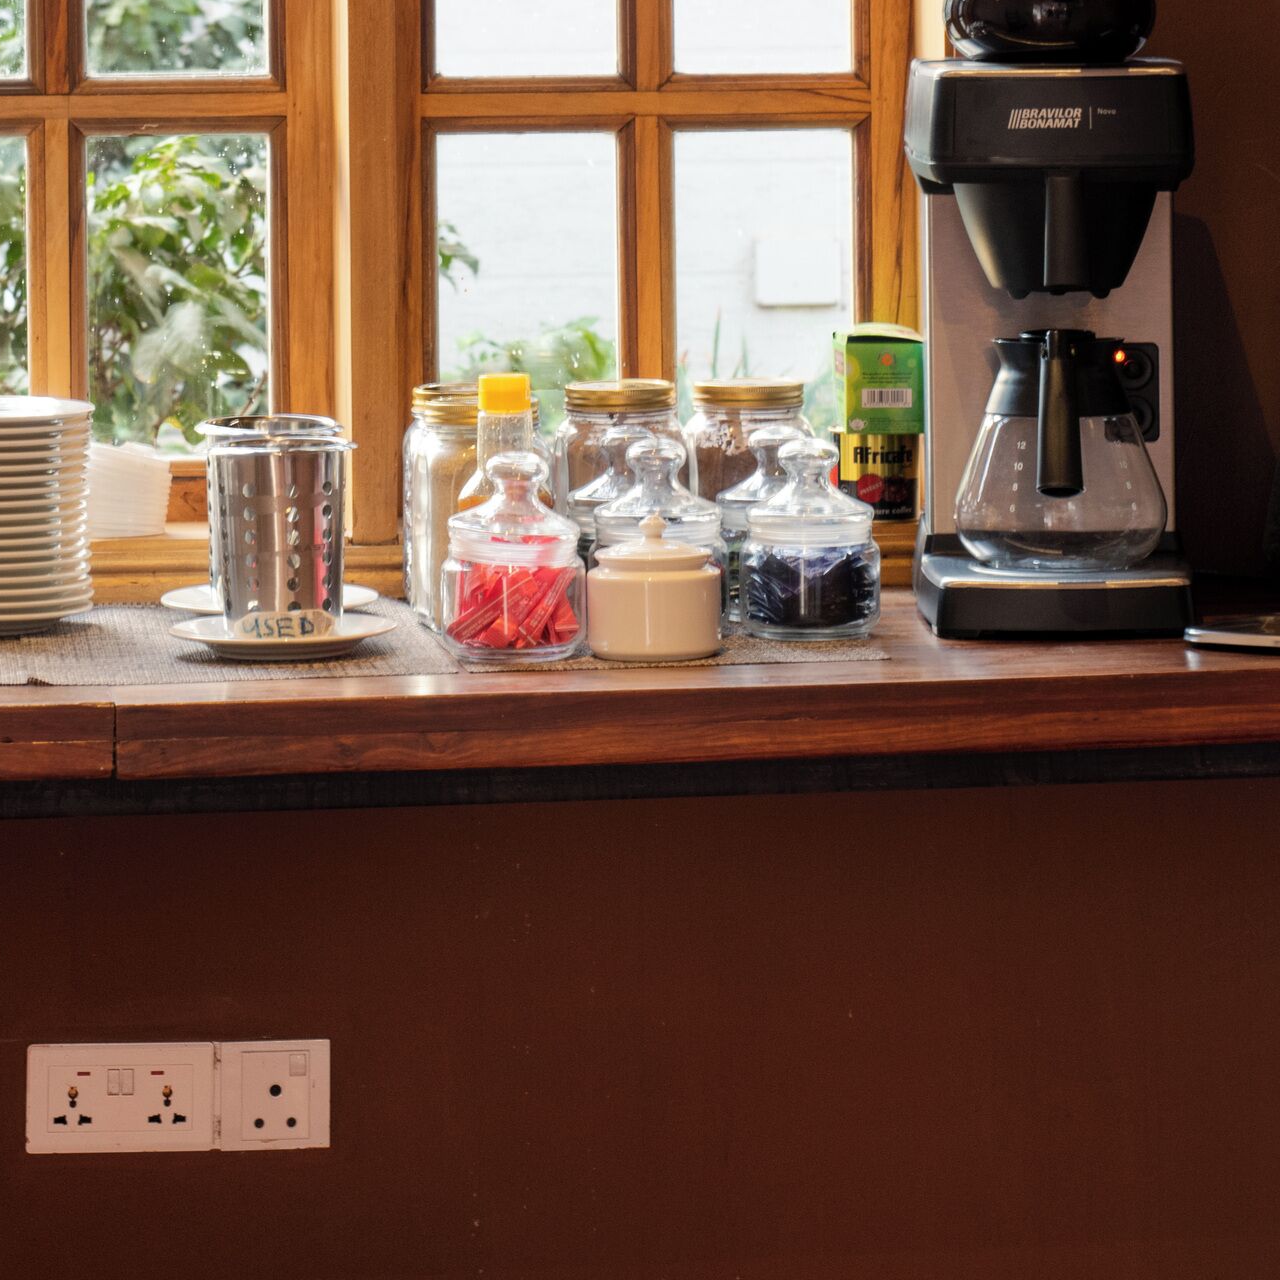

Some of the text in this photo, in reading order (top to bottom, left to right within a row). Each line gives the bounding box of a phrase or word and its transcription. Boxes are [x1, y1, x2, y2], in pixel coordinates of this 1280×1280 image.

[1022, 108, 1082, 118] BRAVILOR
[1020, 118, 1081, 128] BONAMAT
[1017, 441, 1026, 449] 12
[1014, 462, 1023, 471] 10
[1009, 504, 1016, 512] 6
